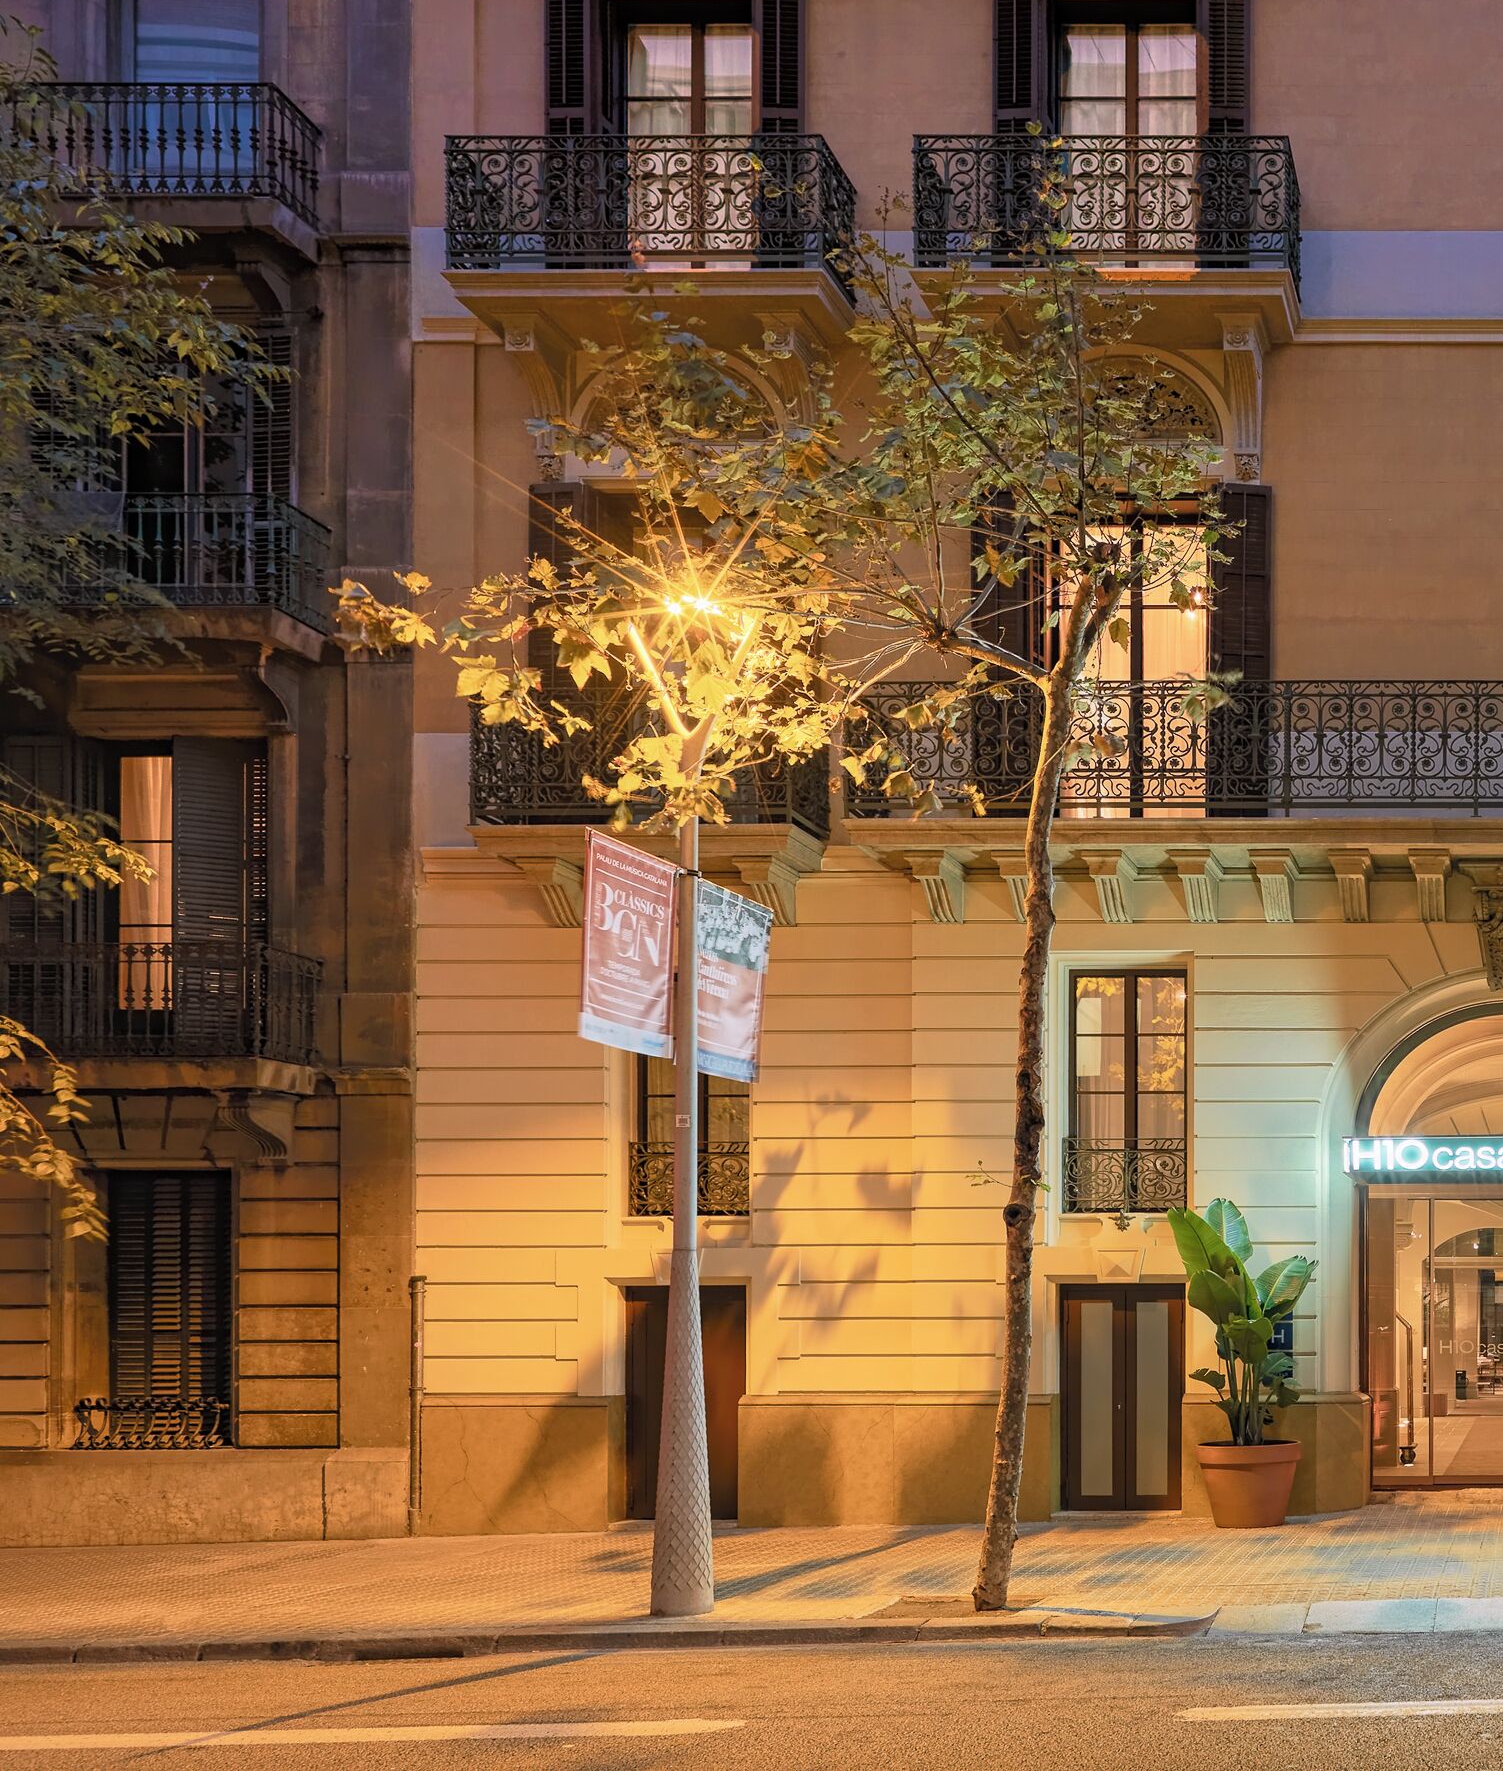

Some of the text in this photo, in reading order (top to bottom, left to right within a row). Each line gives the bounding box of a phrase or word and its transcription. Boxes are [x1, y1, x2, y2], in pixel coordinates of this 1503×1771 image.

[596, 852, 613, 865] PALAU
[614, 889, 665, 920] CLÀSSICS
[1351, 1139, 1430, 1170] H10
[1439, 1339, 1475, 1355] H10
